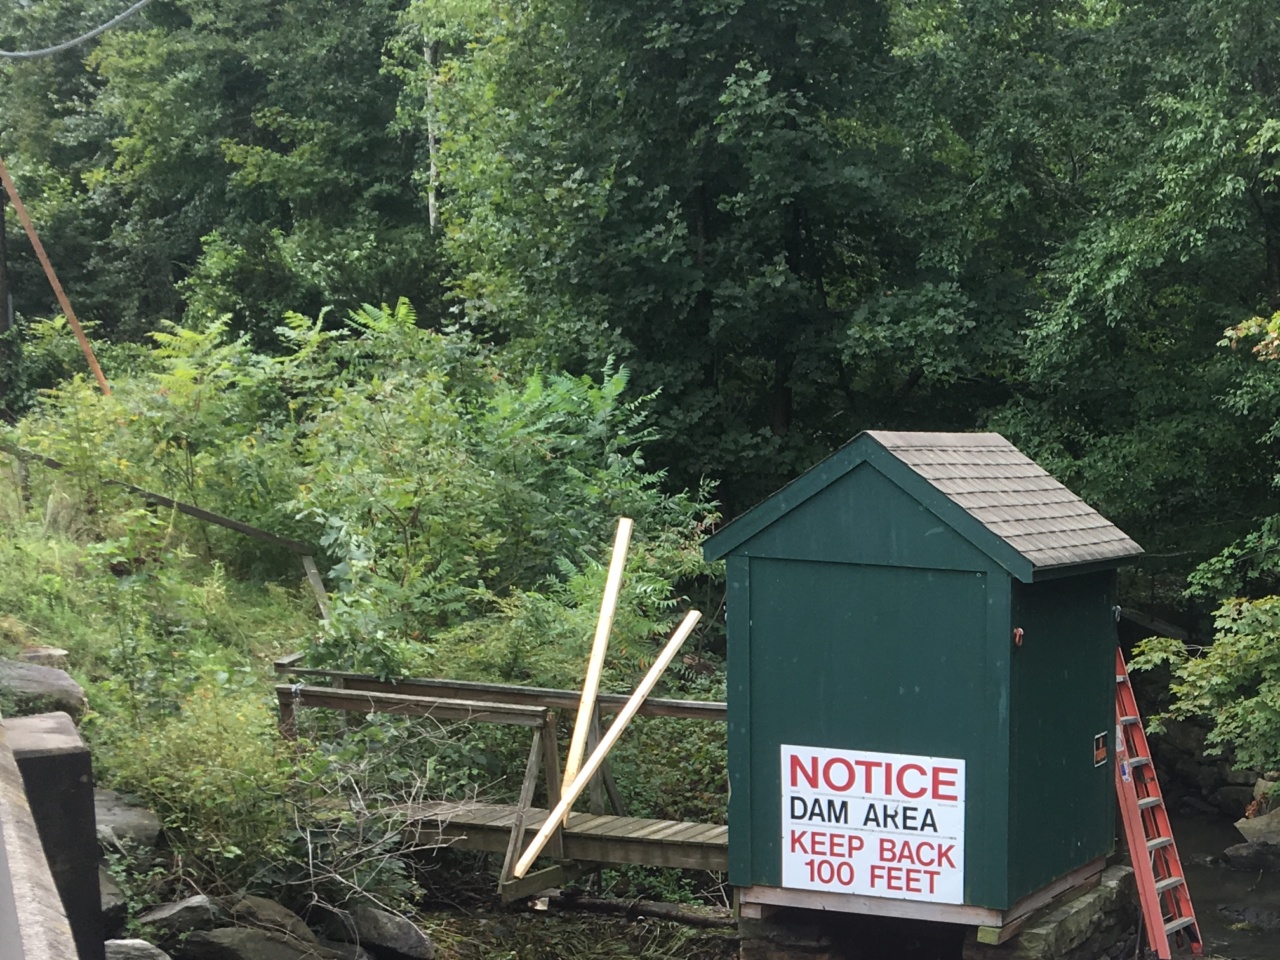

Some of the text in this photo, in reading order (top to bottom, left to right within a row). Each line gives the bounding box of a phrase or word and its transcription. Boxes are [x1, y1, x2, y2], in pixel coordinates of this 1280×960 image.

[790, 754, 958, 802] NOTICE
[790, 796, 938, 833] DAM AREA
[790, 829, 956, 869] KEEP BACK
[805, 859, 941, 894] 100 FEET
